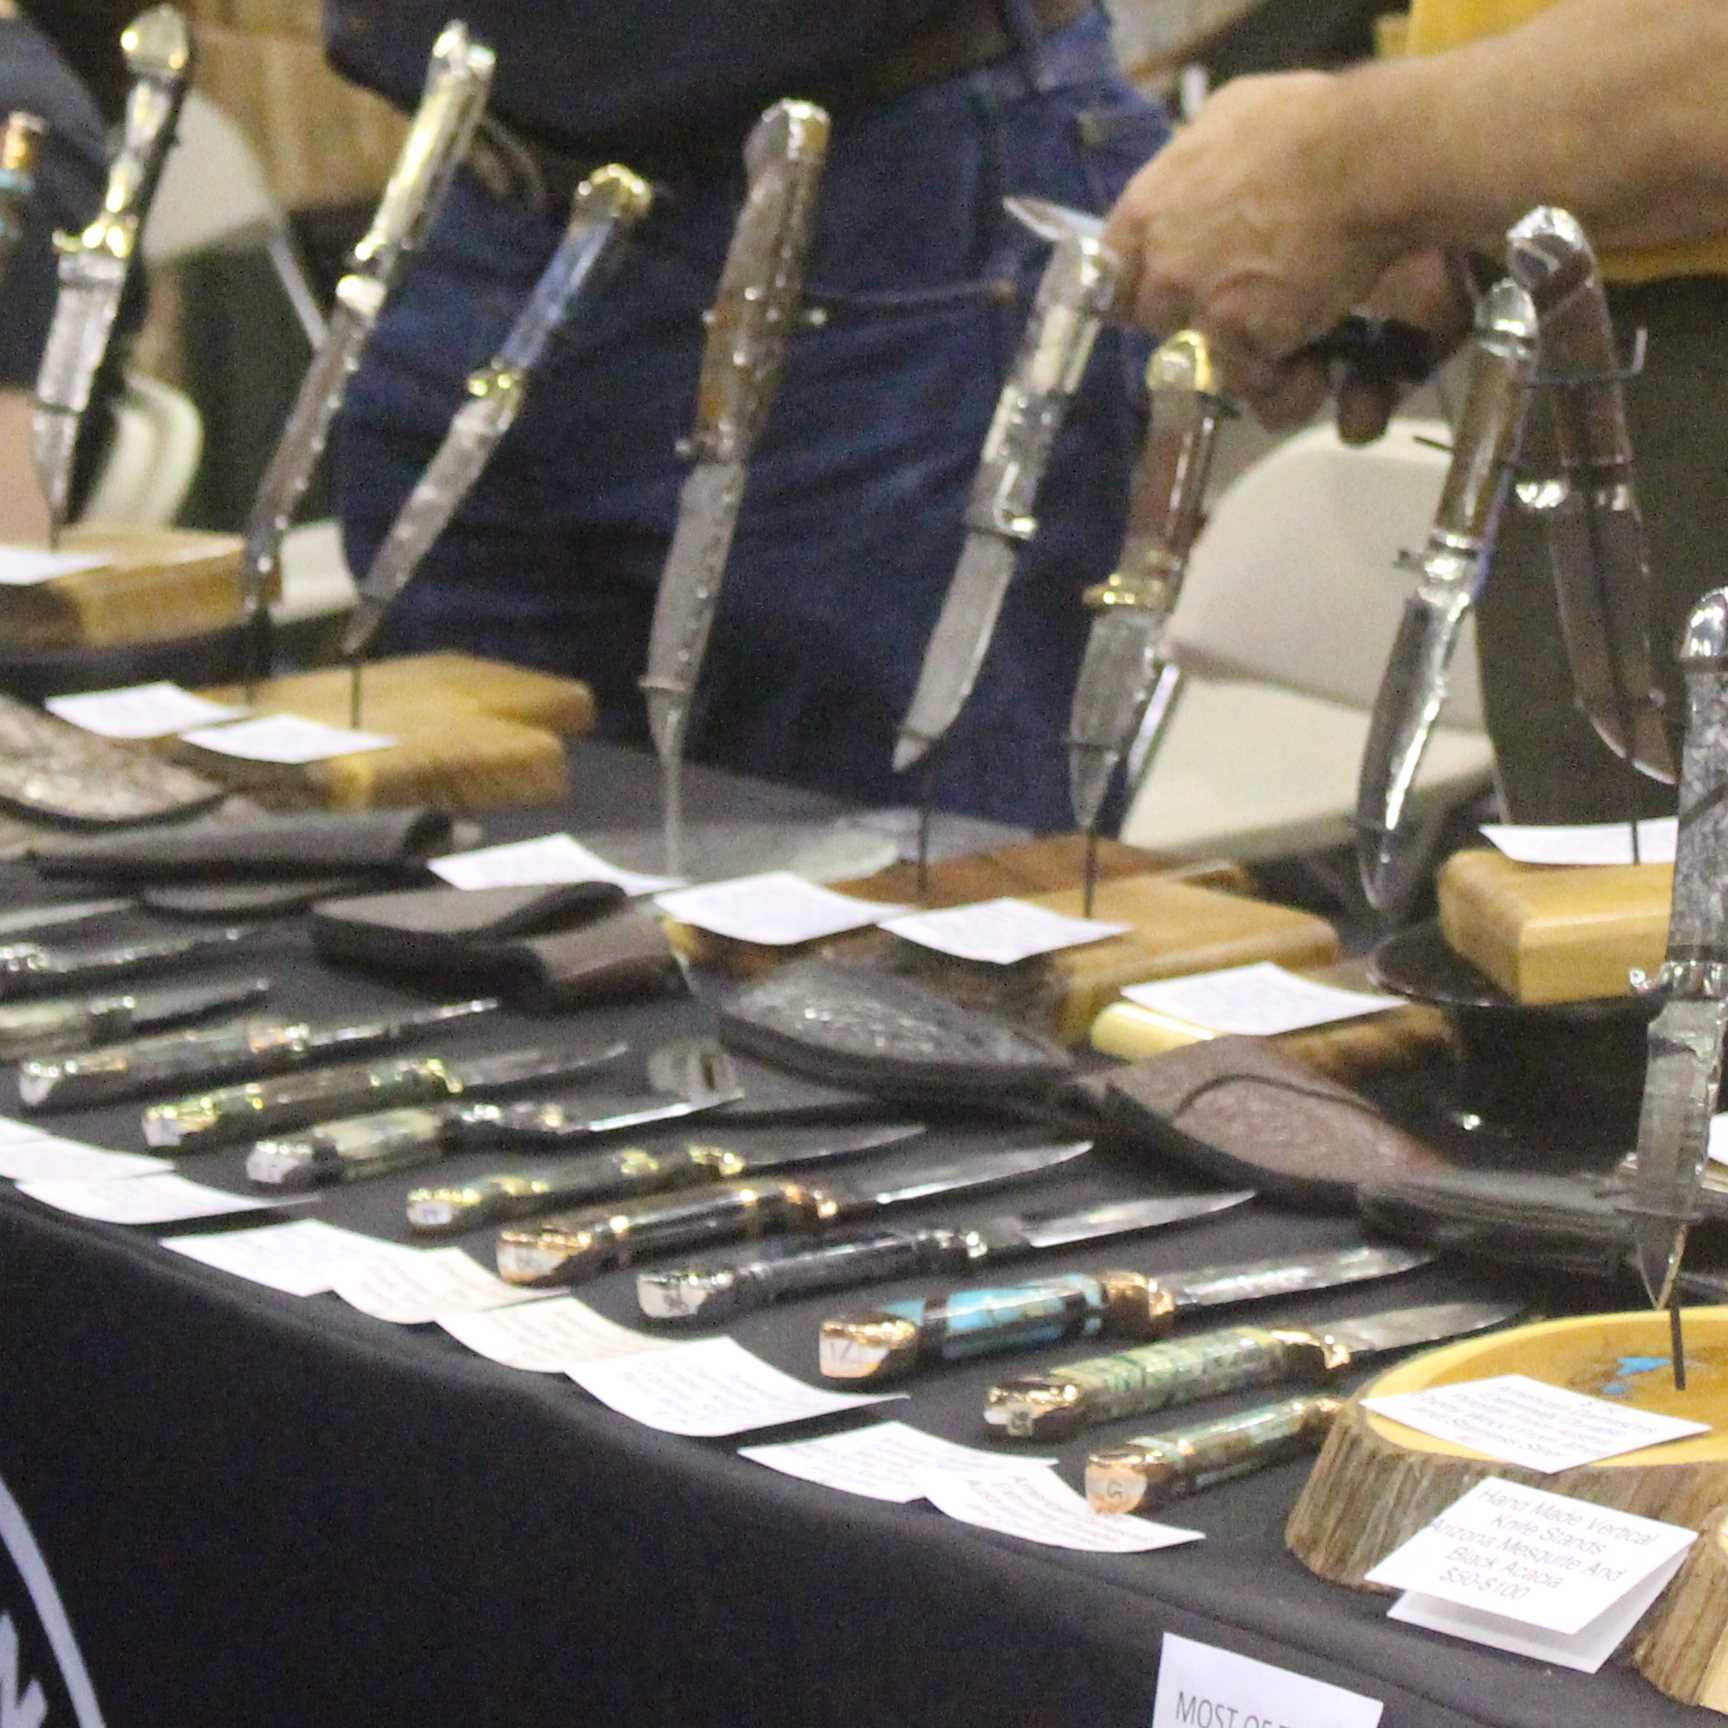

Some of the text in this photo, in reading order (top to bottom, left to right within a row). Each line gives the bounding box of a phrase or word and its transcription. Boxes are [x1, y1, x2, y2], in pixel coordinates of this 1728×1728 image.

[1477, 1487, 1659, 1545] Hand Made Vertical
[1491, 1513, 1607, 1556] Knife Stands
[1430, 1518, 1628, 1583] Arizona Mesquite And
[1445, 1545, 1565, 1589] Black Acacia
